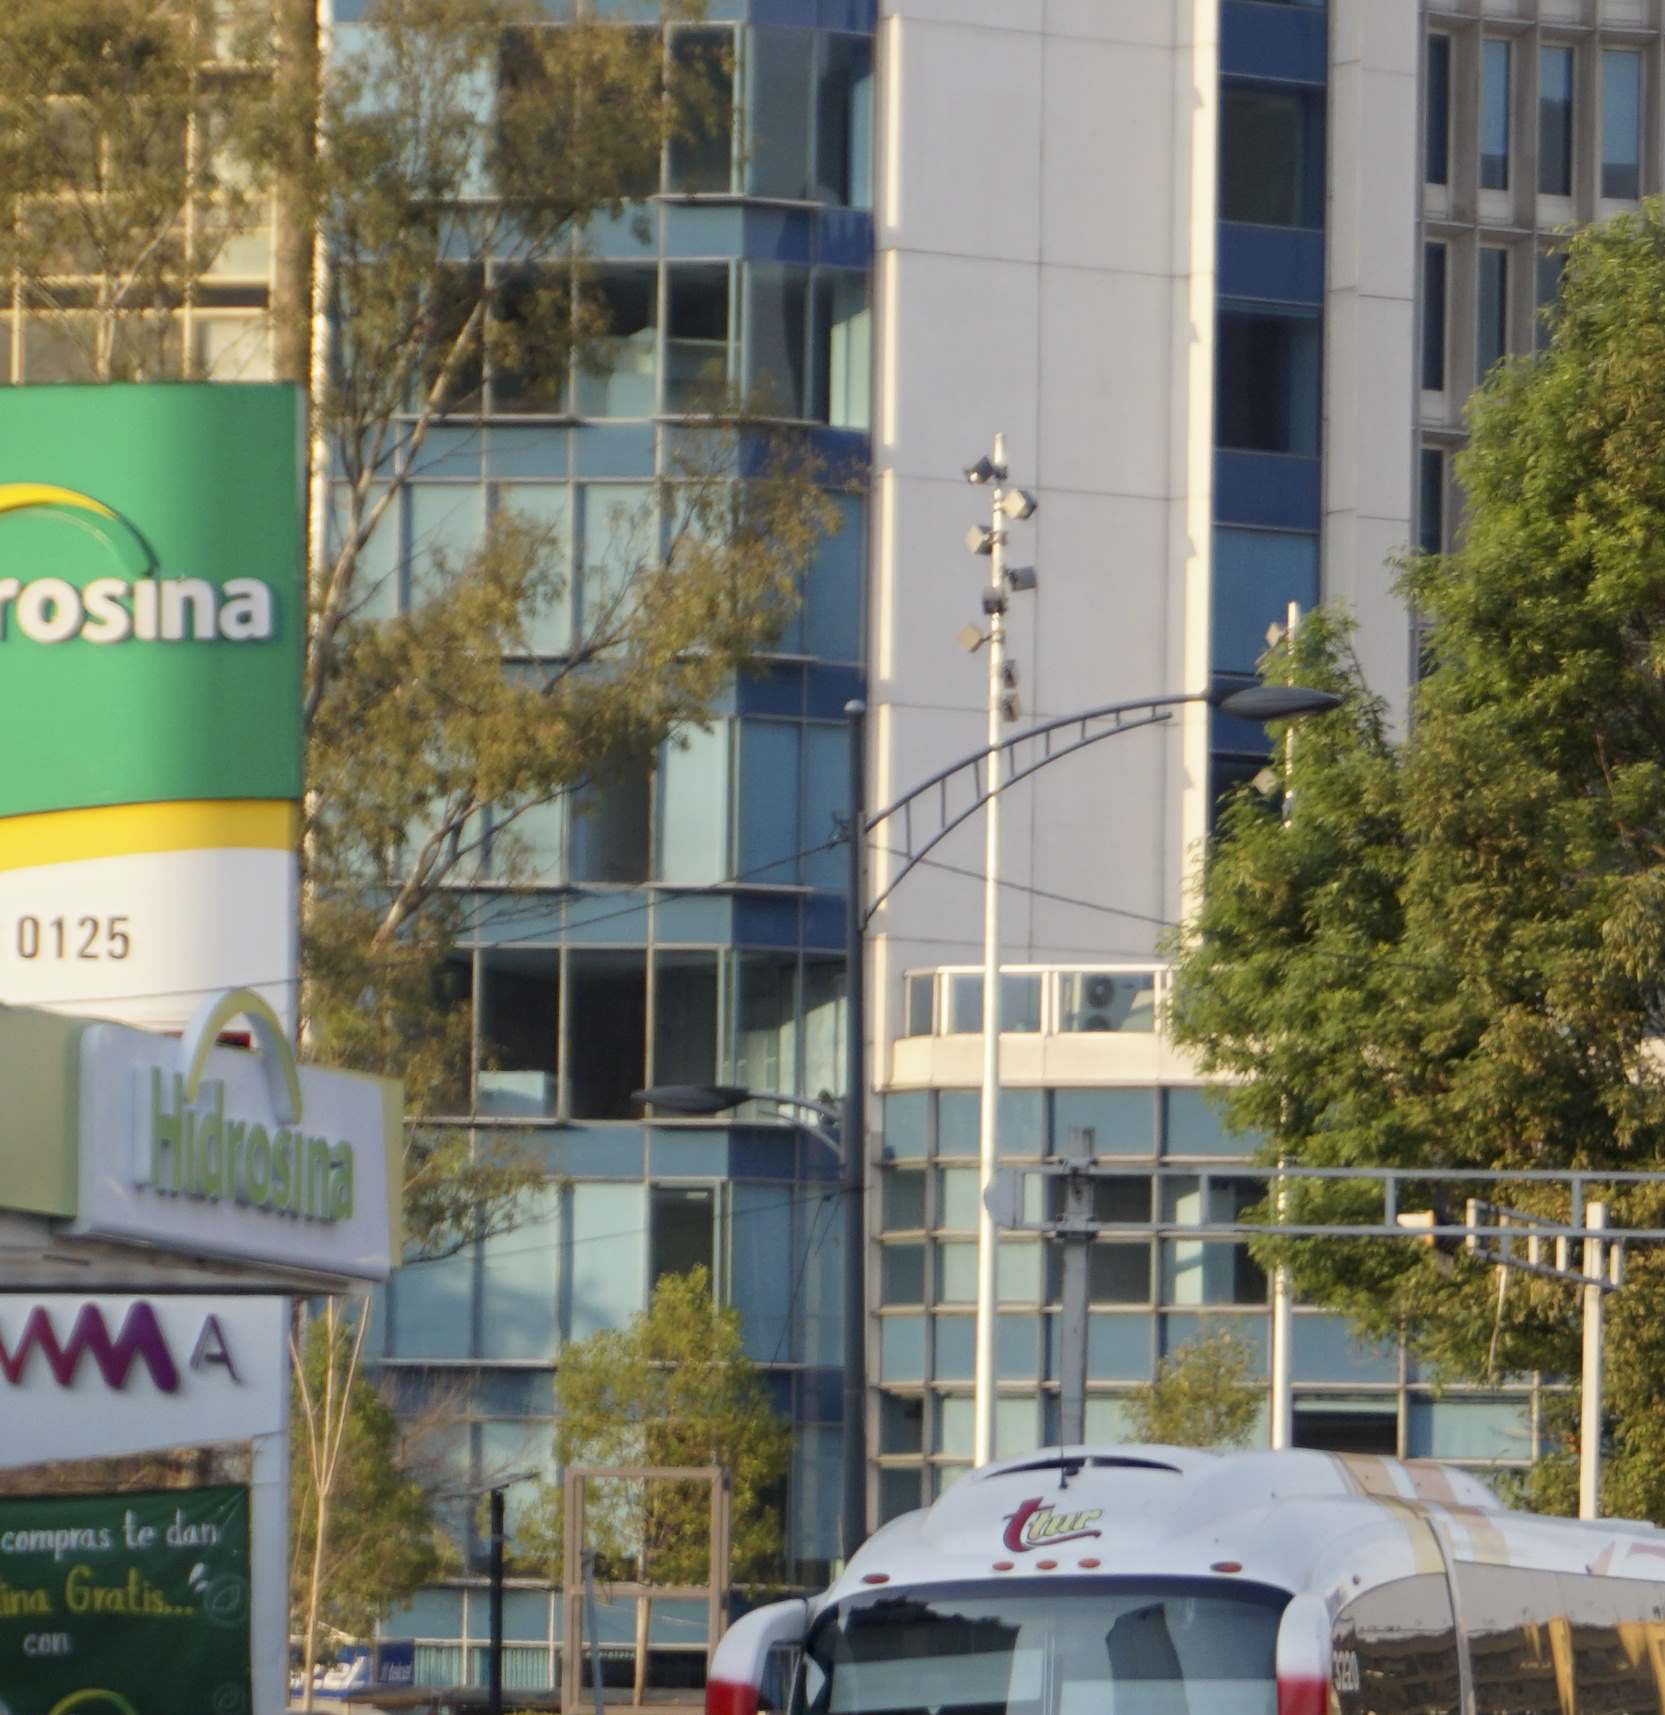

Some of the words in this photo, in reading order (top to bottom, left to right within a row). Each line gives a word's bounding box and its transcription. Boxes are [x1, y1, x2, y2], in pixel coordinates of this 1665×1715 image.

[17, 916, 131, 960] 0125
[150, 1065, 354, 1221] Hidrosina
[1, 1526, 111, 1561] compras
[125, 1508, 156, 1547] te
[166, 1506, 219, 1547] dan
[23, 1632, 71, 1656] con
